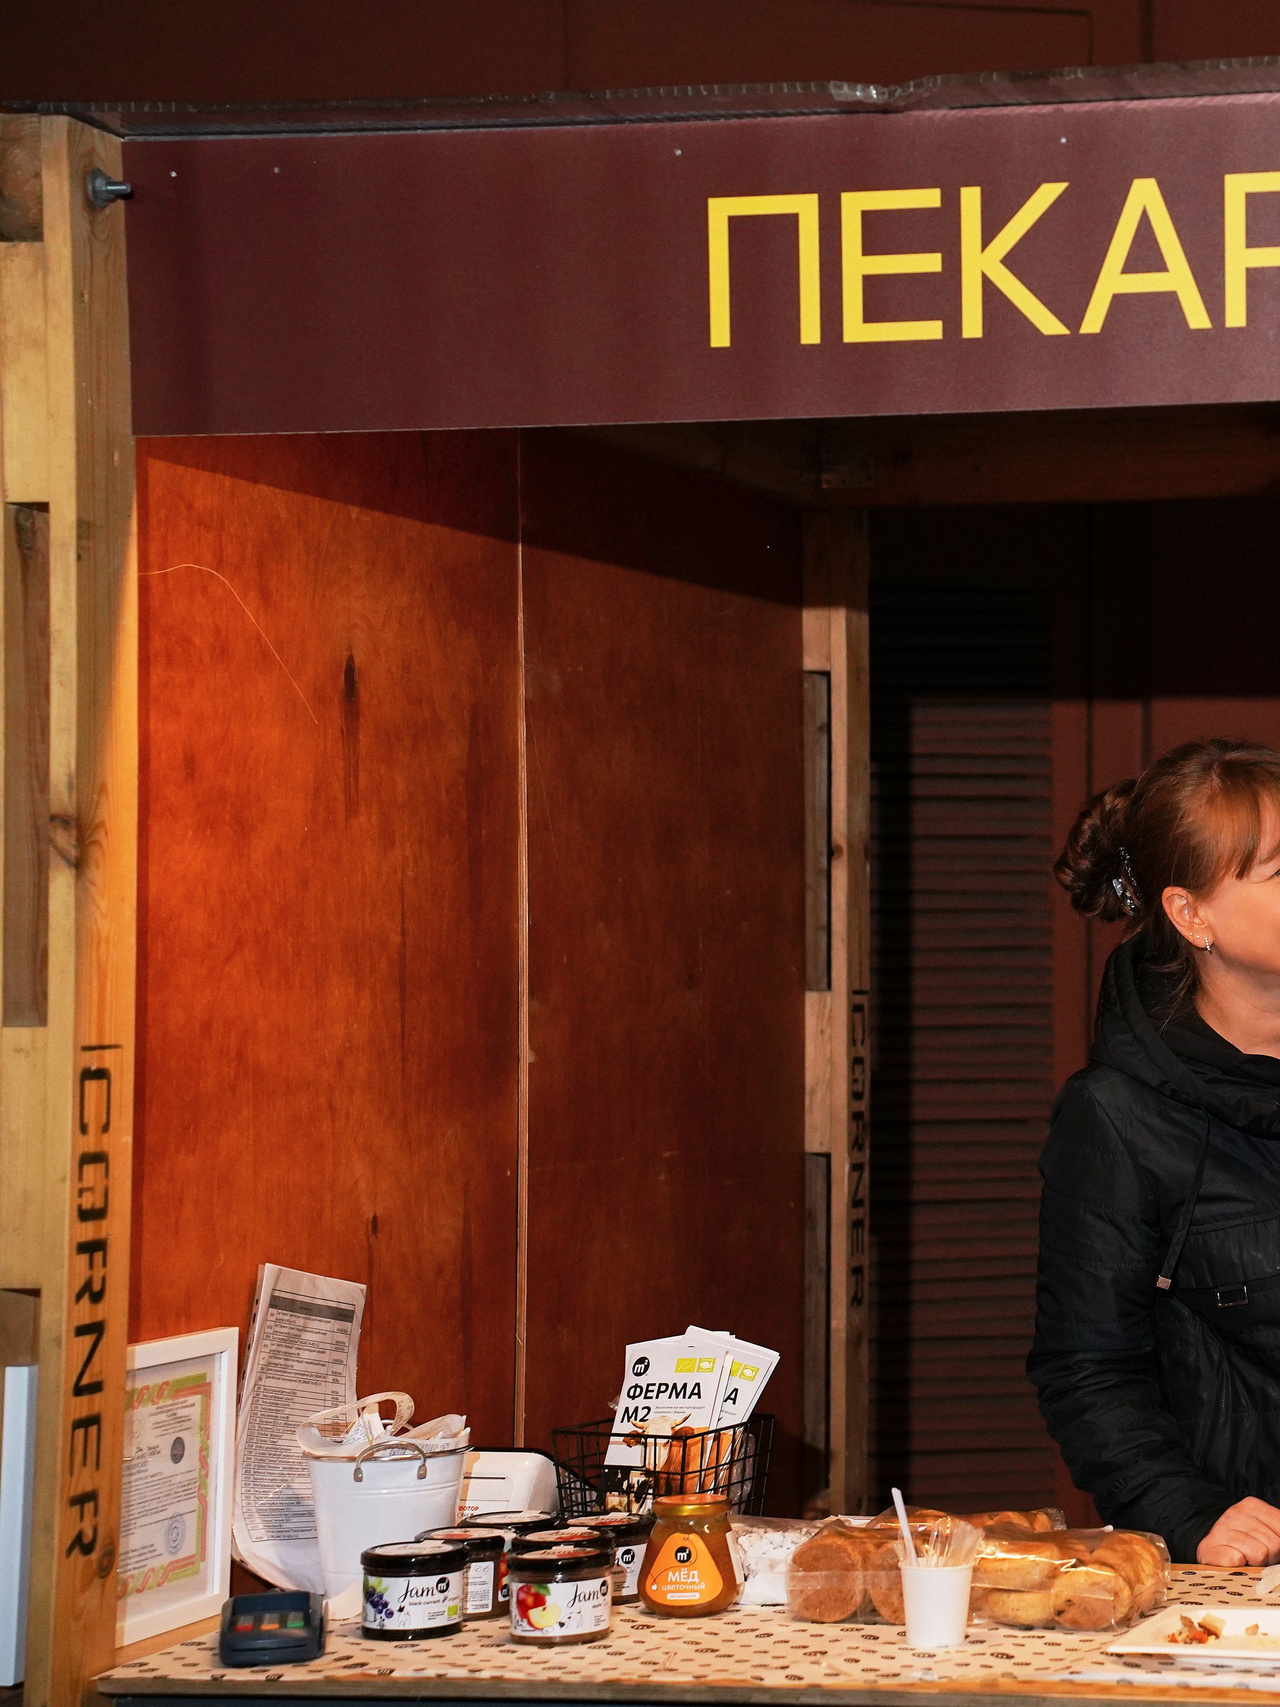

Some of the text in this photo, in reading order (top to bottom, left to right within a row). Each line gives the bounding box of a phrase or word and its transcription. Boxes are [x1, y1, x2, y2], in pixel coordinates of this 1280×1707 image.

[626, 1382, 702, 1401] ФЕРМА
[620, 1405, 652, 1424] М2
[668, 1568, 699, 1584] МЁД
[398, 1578, 435, 1604] Jam
[566, 1583, 599, 1609] Jam
[662, 1582, 706, 1591] цветочный
